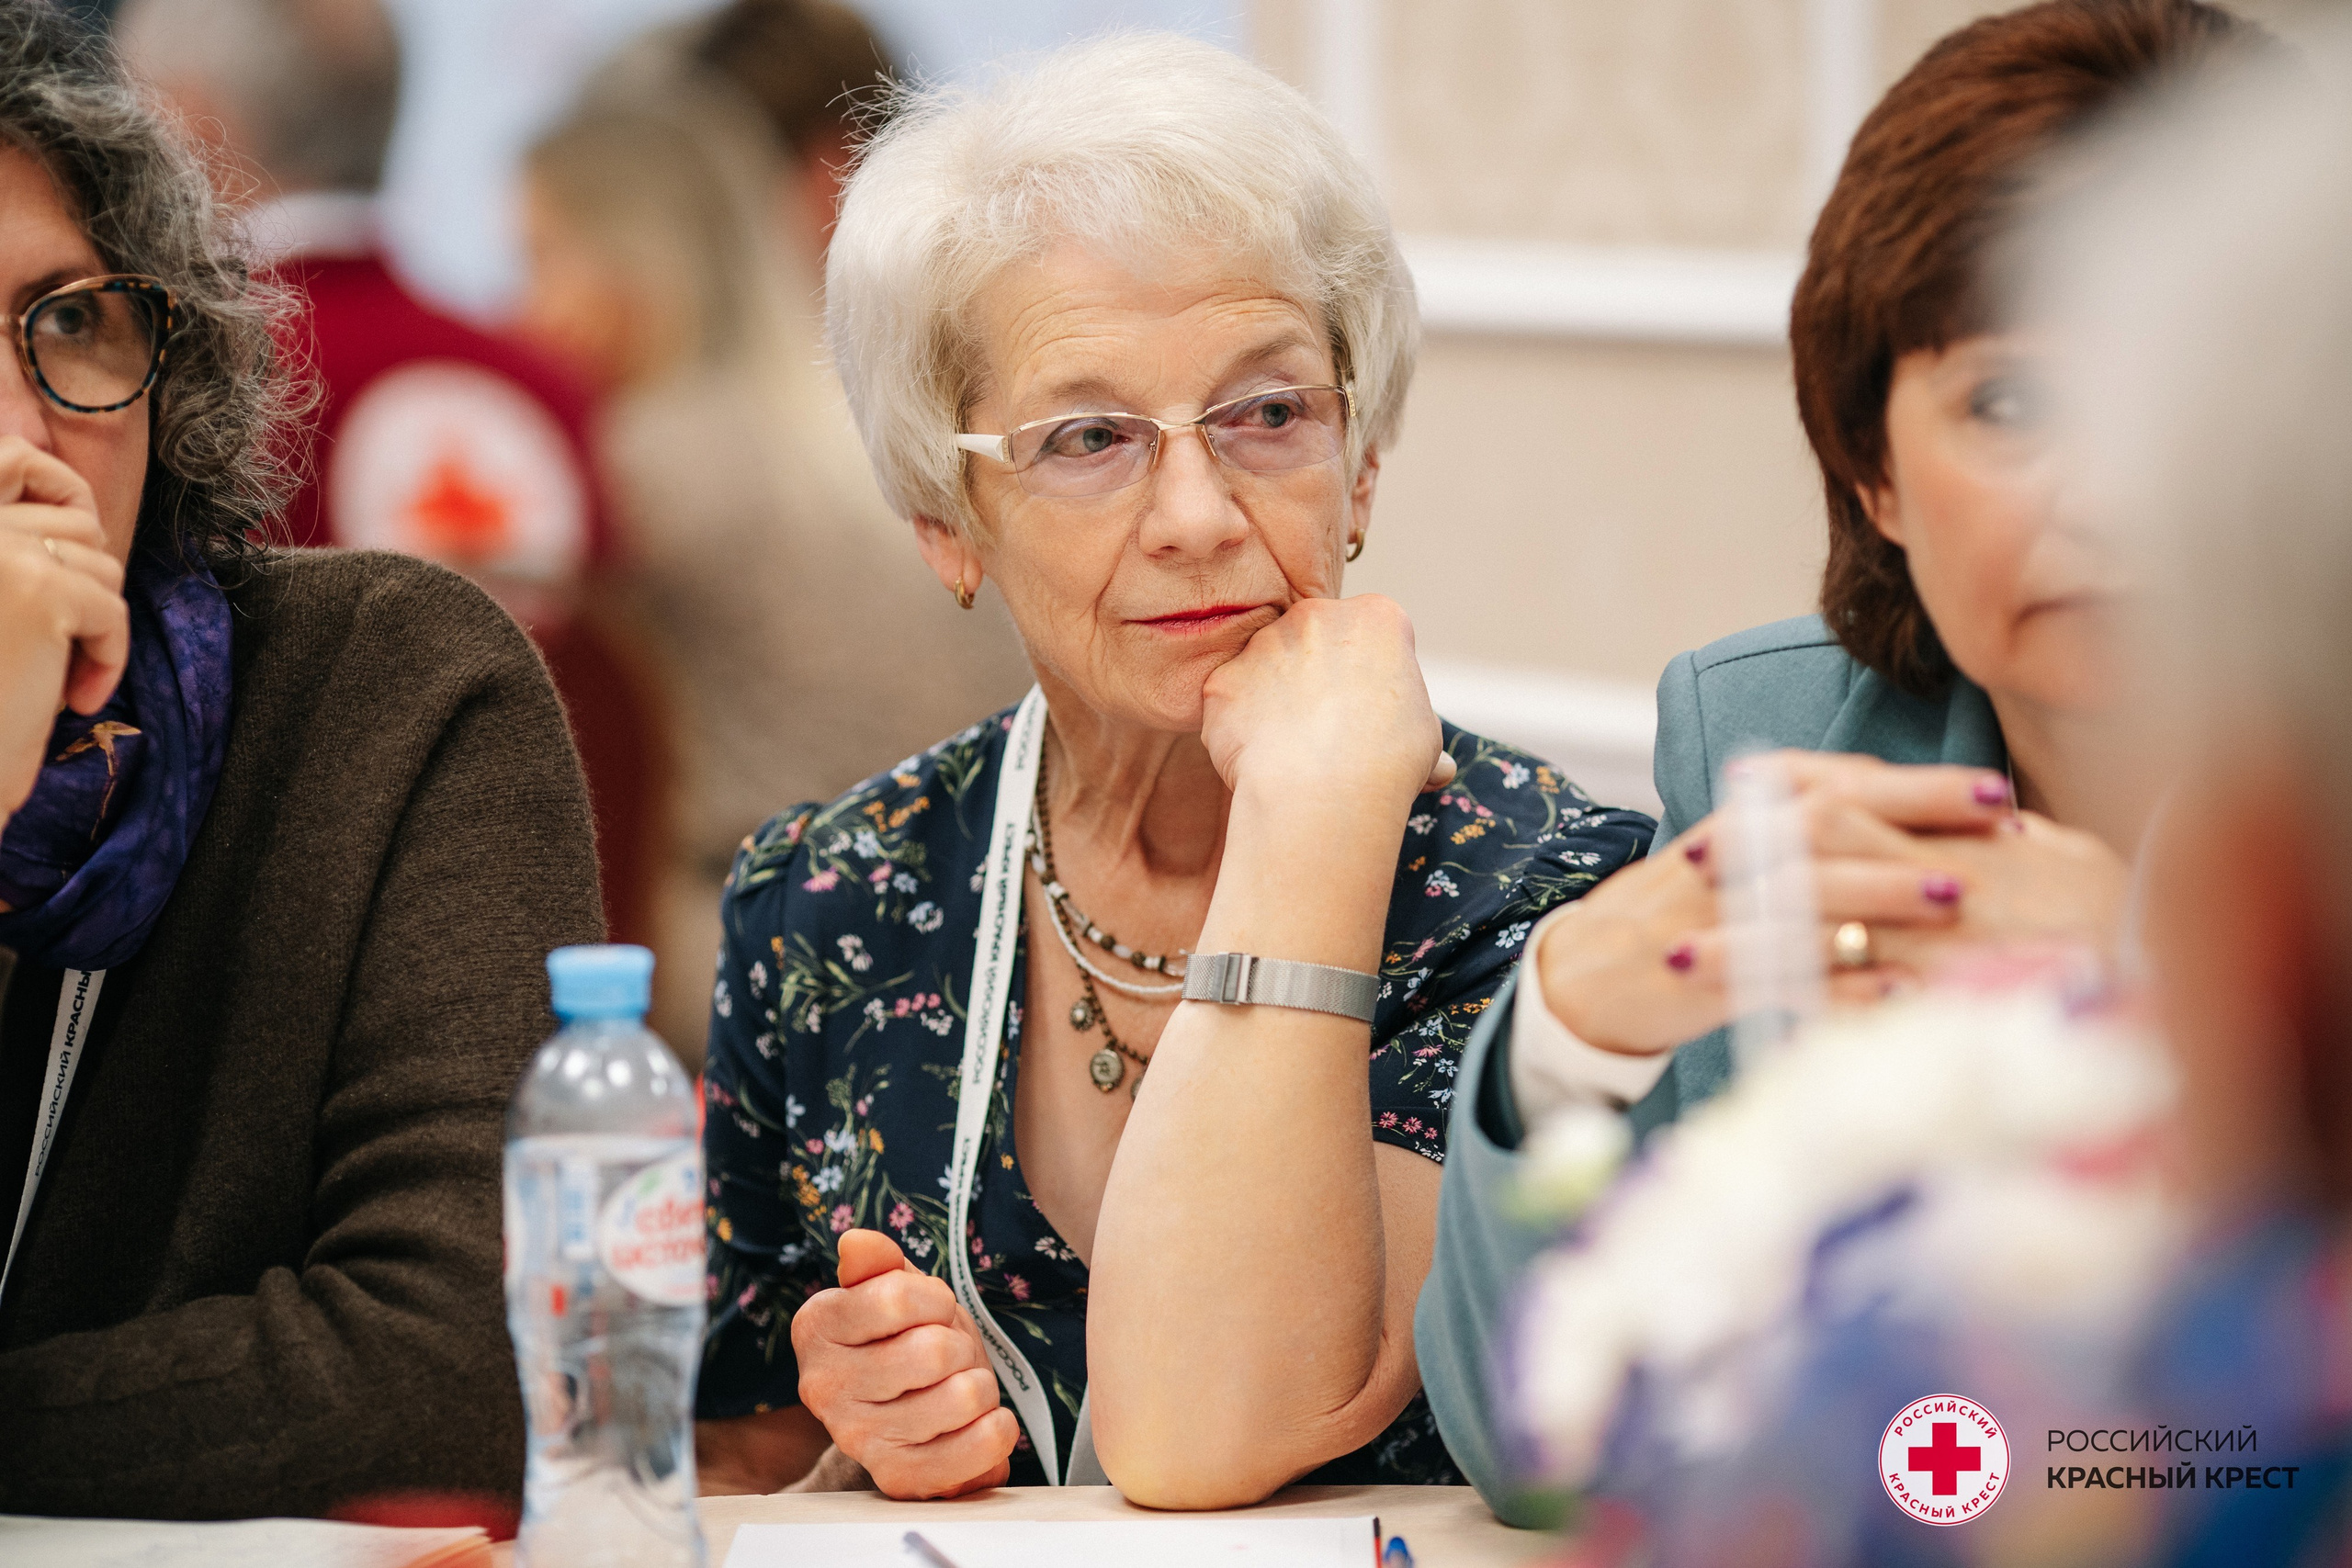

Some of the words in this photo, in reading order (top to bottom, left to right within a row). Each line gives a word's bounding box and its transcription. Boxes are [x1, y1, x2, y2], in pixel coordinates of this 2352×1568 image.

[972, 966, 997, 1085] РОССИЙСКИЙ
[989, 877, 1008, 963] КРАСНЫЙ
[1002, 823, 1015, 874] КРЕСТ
[34, 1050, 71, 1177] РОССИЙСКИЙ
[64, 970, 92, 1047] КРАСНЫ
[960, 1283, 1030, 1392] РОССИЙСКИЙ
